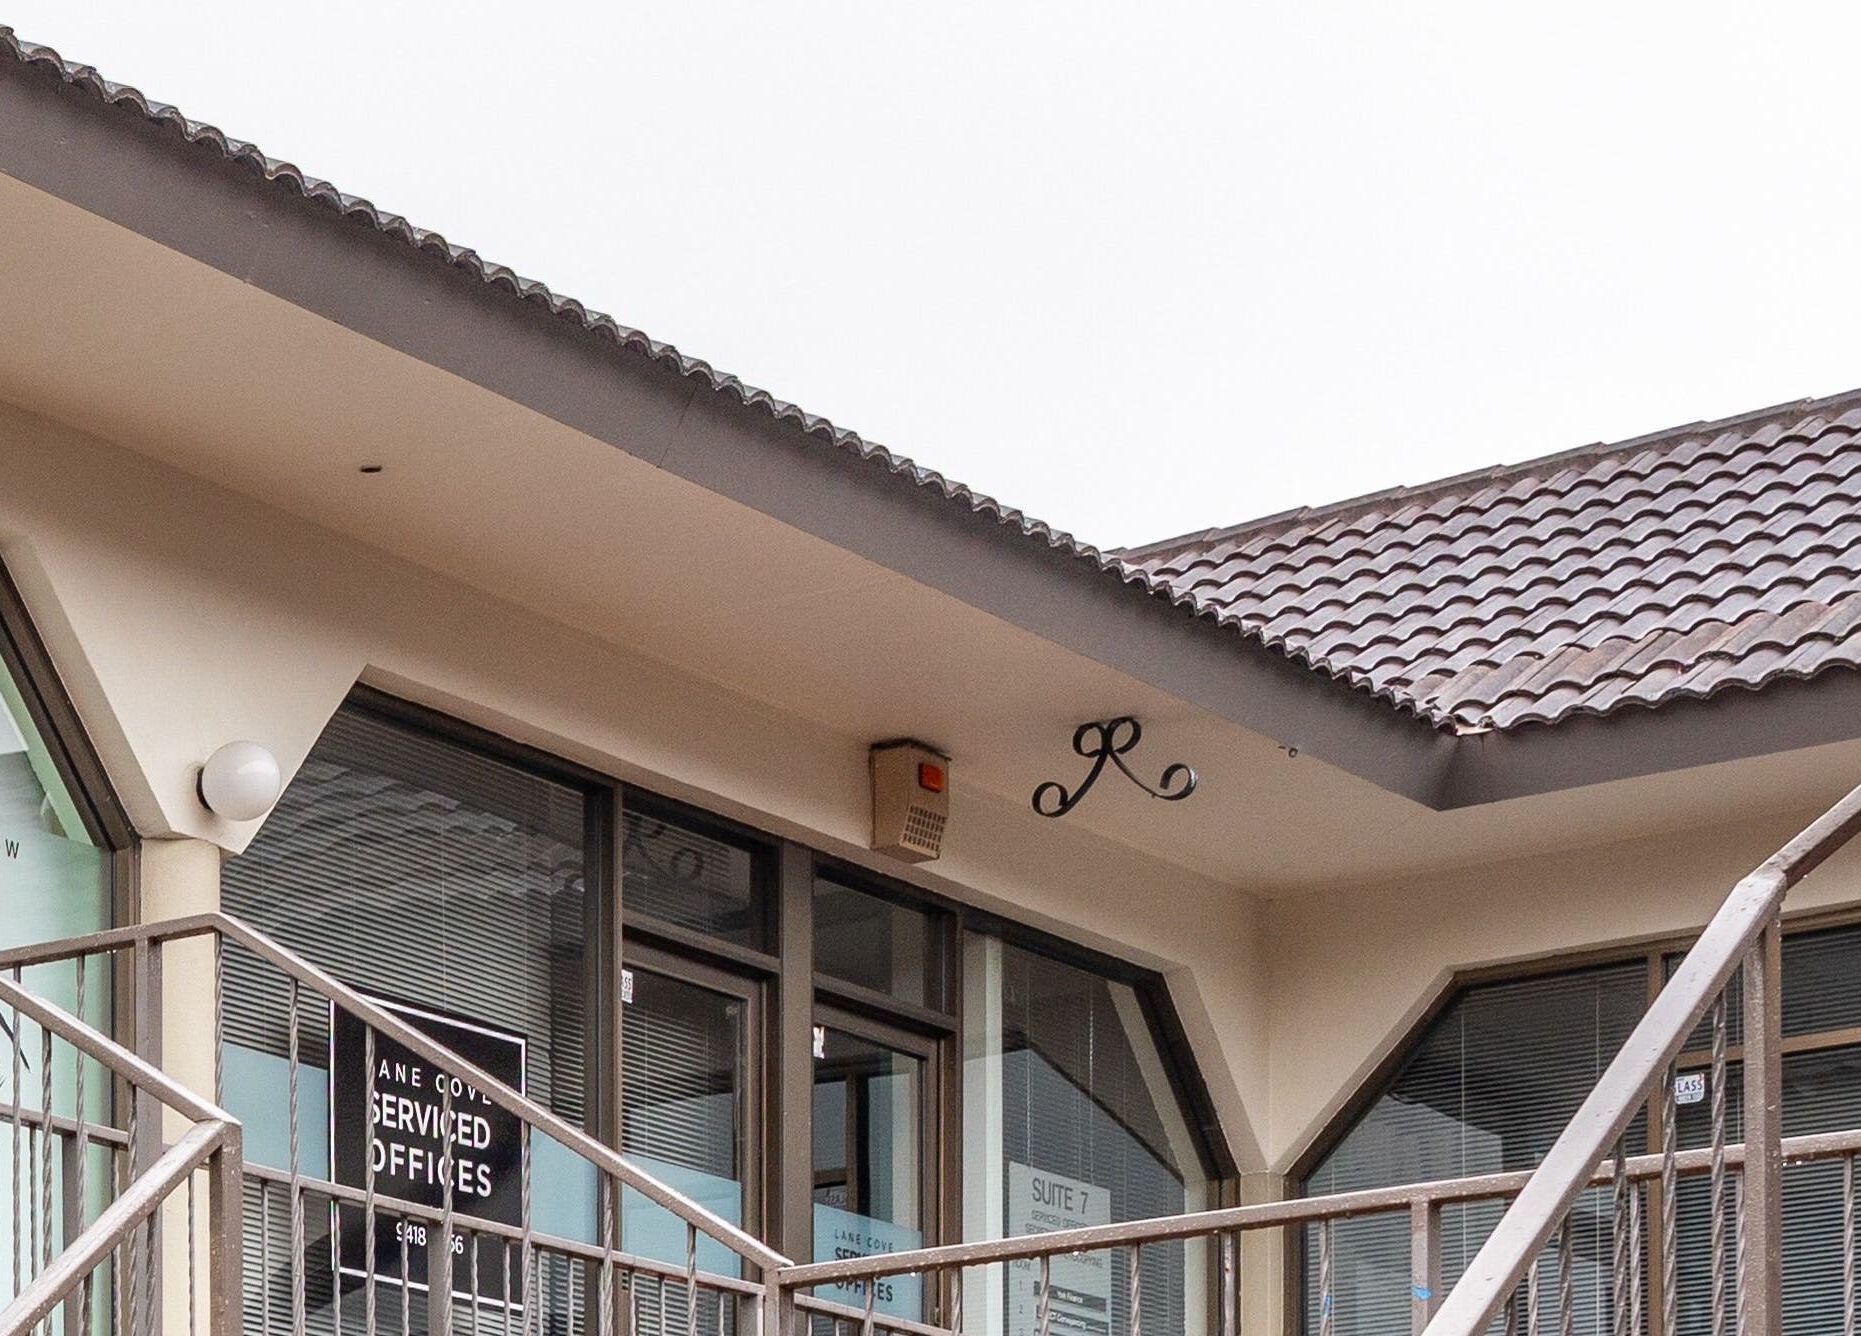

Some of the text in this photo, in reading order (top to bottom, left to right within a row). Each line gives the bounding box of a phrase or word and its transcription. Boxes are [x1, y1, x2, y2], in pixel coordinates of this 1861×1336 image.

[373, 1058, 422, 1088] ANE
[1677, 1079, 1703, 1094] LASS
[1032, 1177, 1089, 1215] SUITE 7
[834, 1228, 894, 1253] LANE COVE
[835, 1275, 894, 1303] OFFIES
